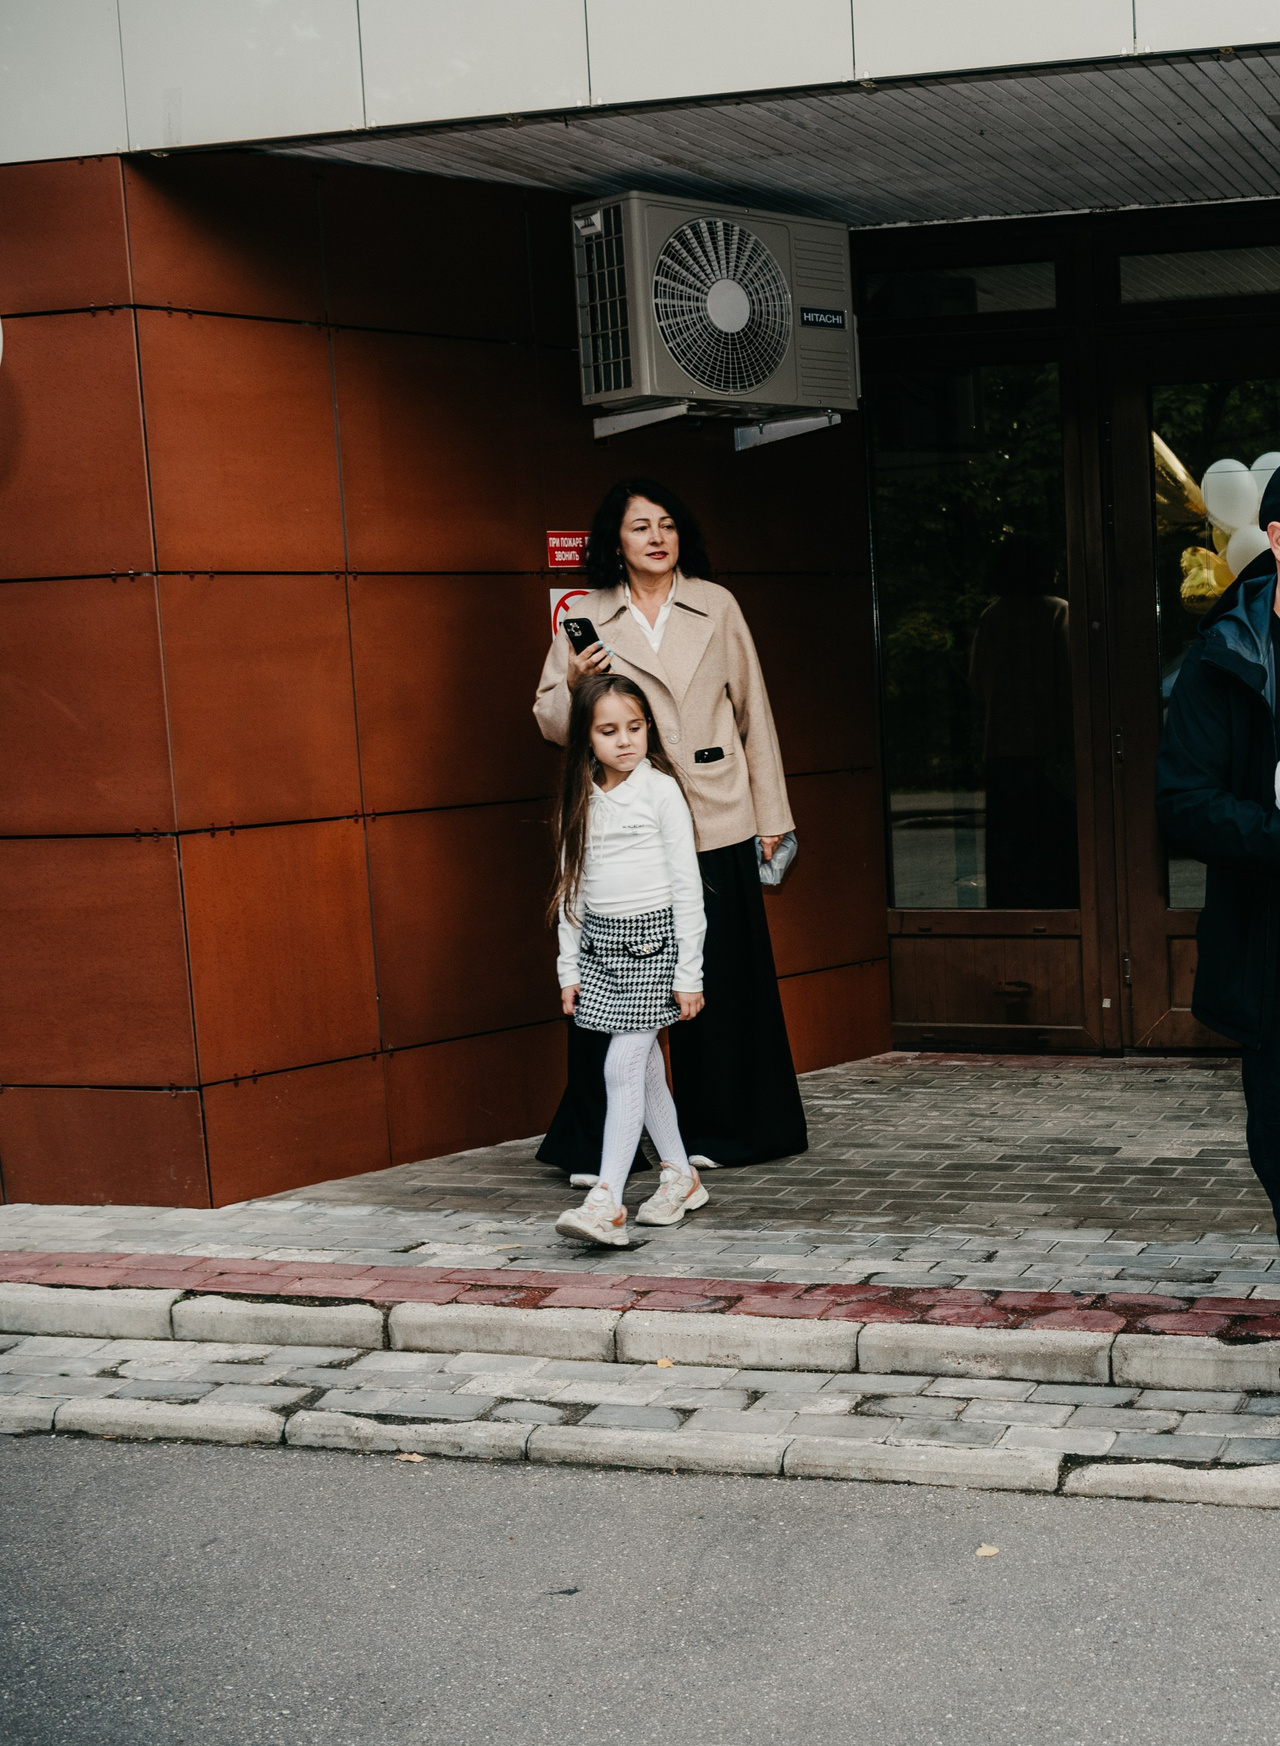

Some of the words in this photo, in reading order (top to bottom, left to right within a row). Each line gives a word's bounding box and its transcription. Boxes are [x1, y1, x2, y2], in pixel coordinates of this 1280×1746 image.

[803, 312, 842, 324] HITACHI
[549, 537, 560, 548] ПРИ
[560, 537, 583, 548] ПОЖАРЕ
[555, 551, 580, 561] ЗВОНИТЬ
